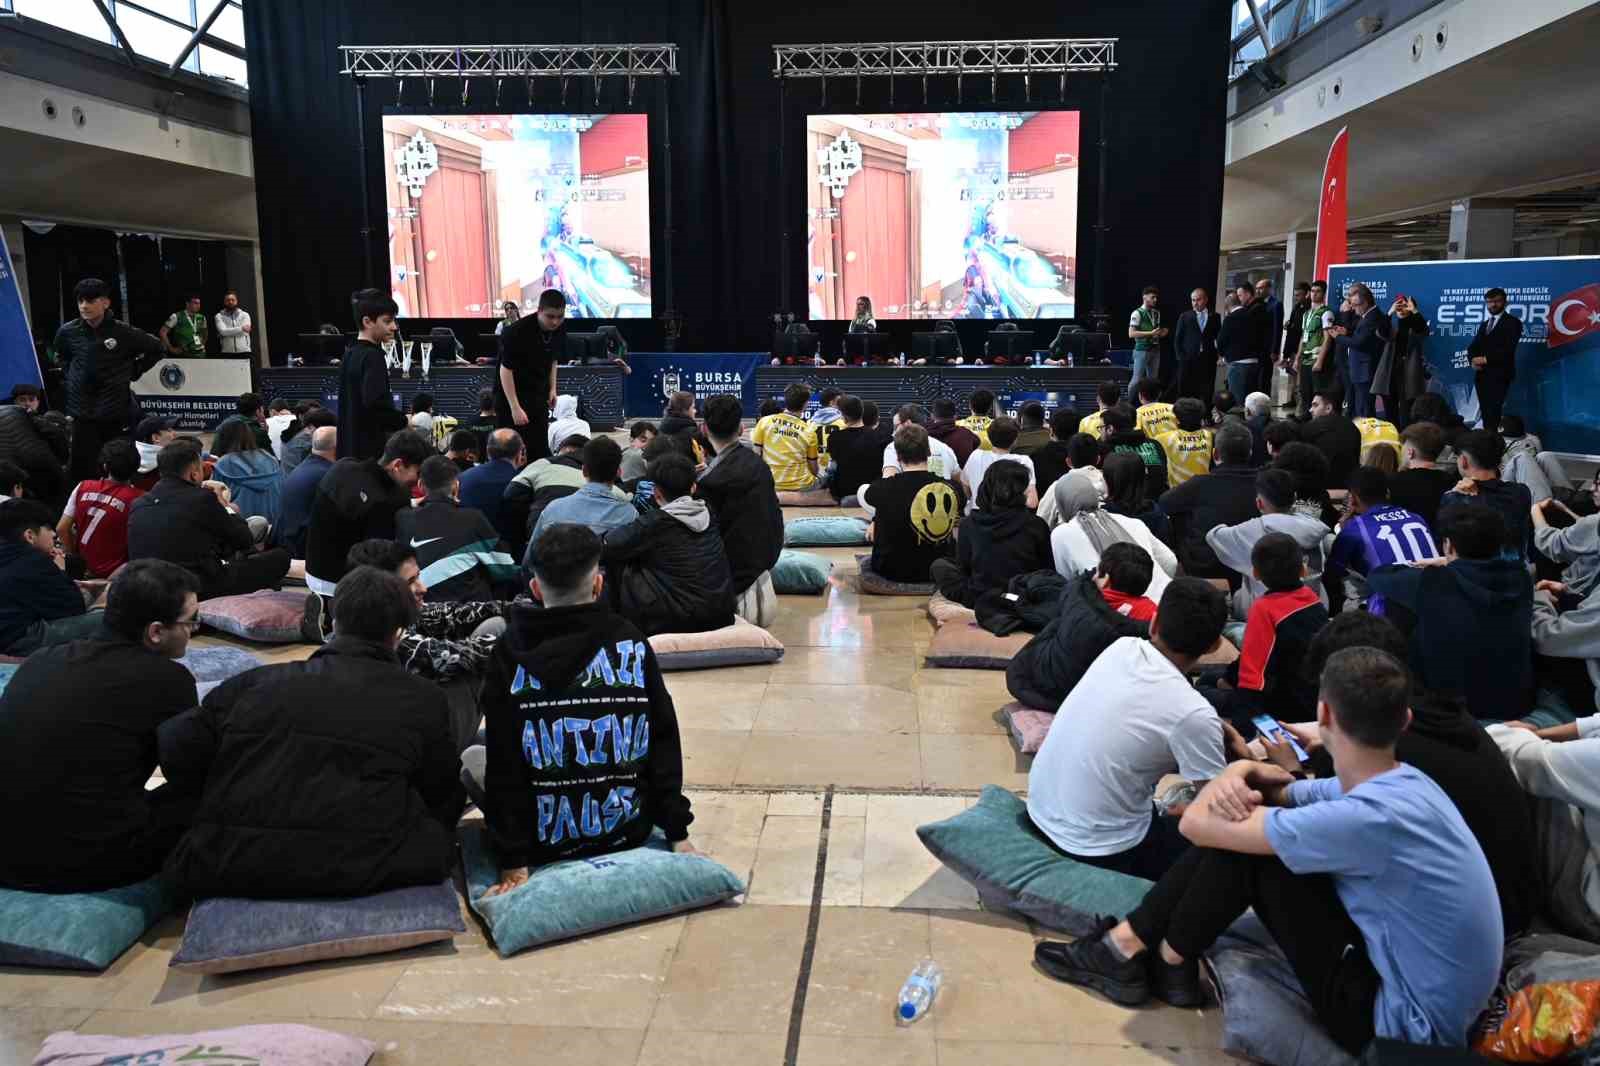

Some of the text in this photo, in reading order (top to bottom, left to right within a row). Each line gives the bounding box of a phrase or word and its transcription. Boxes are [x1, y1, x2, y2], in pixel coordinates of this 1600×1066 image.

[695, 372, 742, 383] BURSA
[695, 383, 742, 394] BÜYÜKŞEHİR
[141, 400, 237, 411] BÜYÜKŞEHİR BELEDİYES
[1374, 510, 1411, 521] MESSI
[81, 507, 106, 544] 7
[1376, 522, 1440, 565] 10
